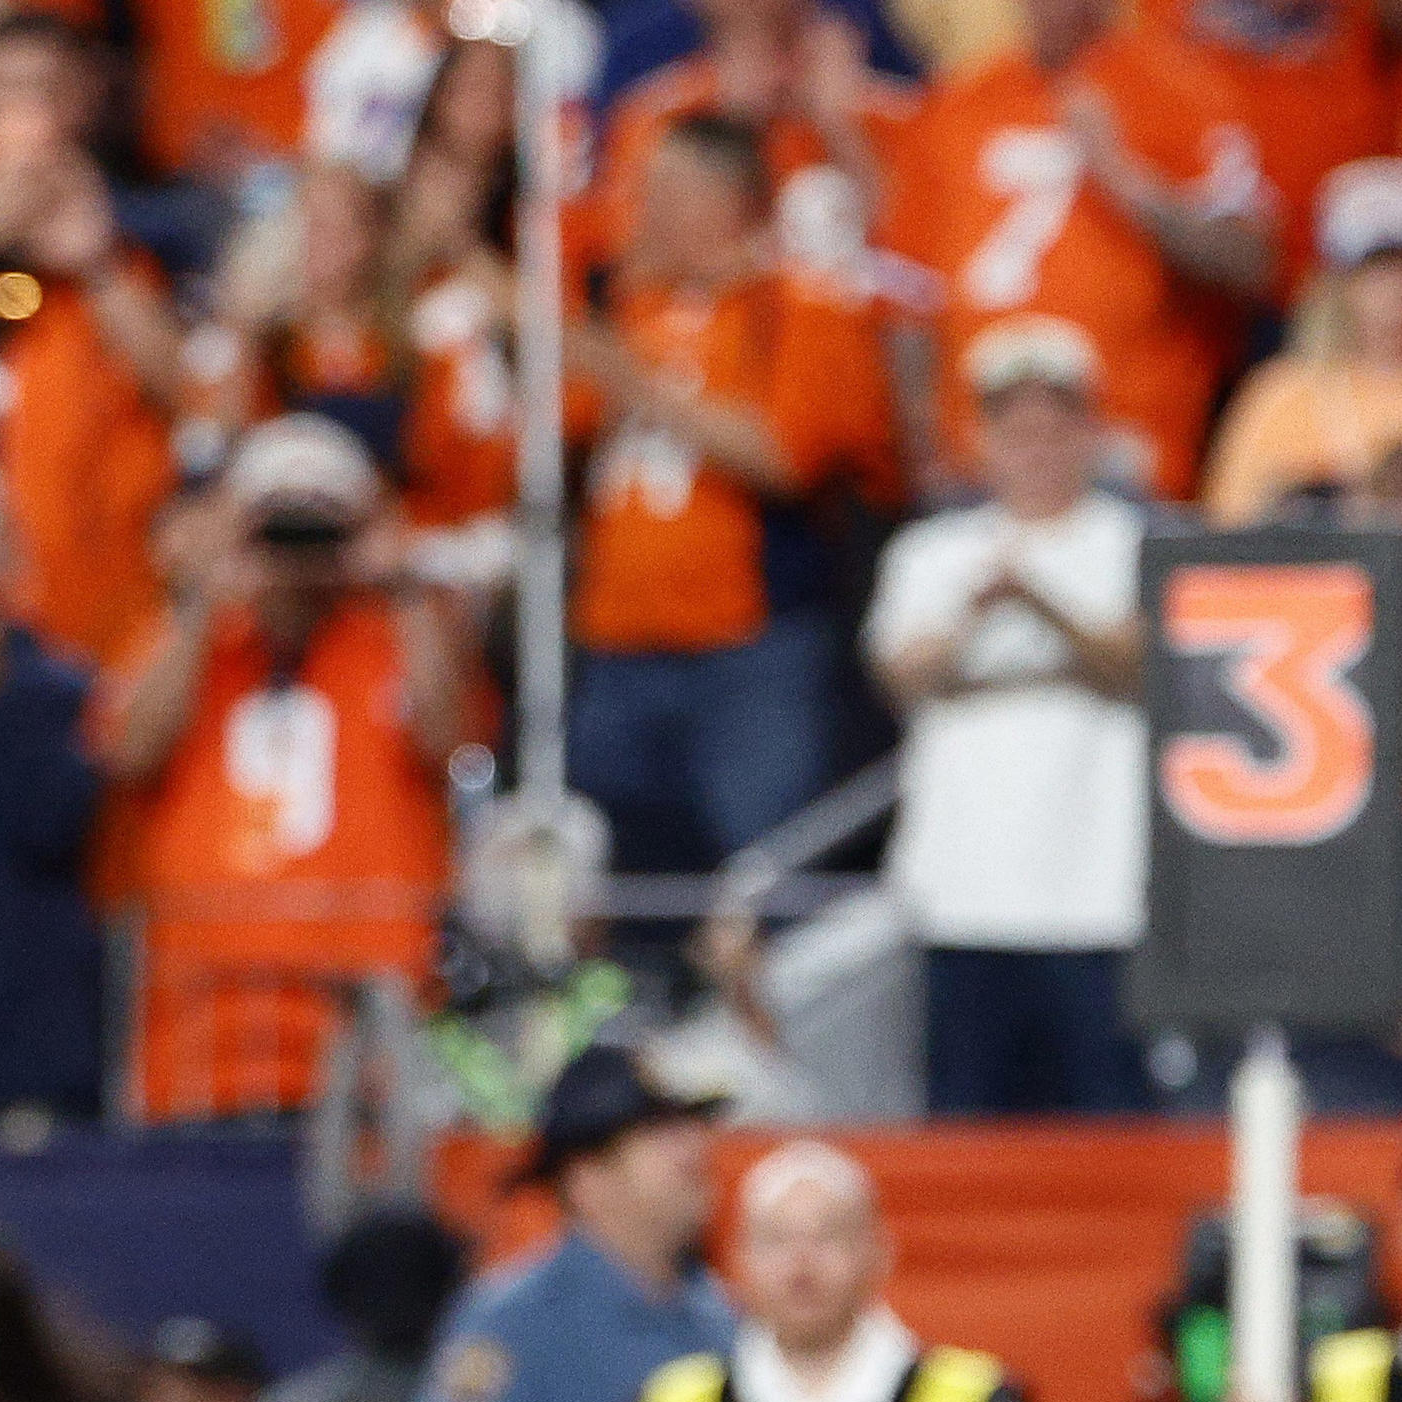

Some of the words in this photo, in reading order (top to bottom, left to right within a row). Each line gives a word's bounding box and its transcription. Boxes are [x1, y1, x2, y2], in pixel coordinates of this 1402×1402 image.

[964, 124, 1087, 308] 7
[222, 684, 340, 856] 9
[1162, 563, 1376, 845] 3
